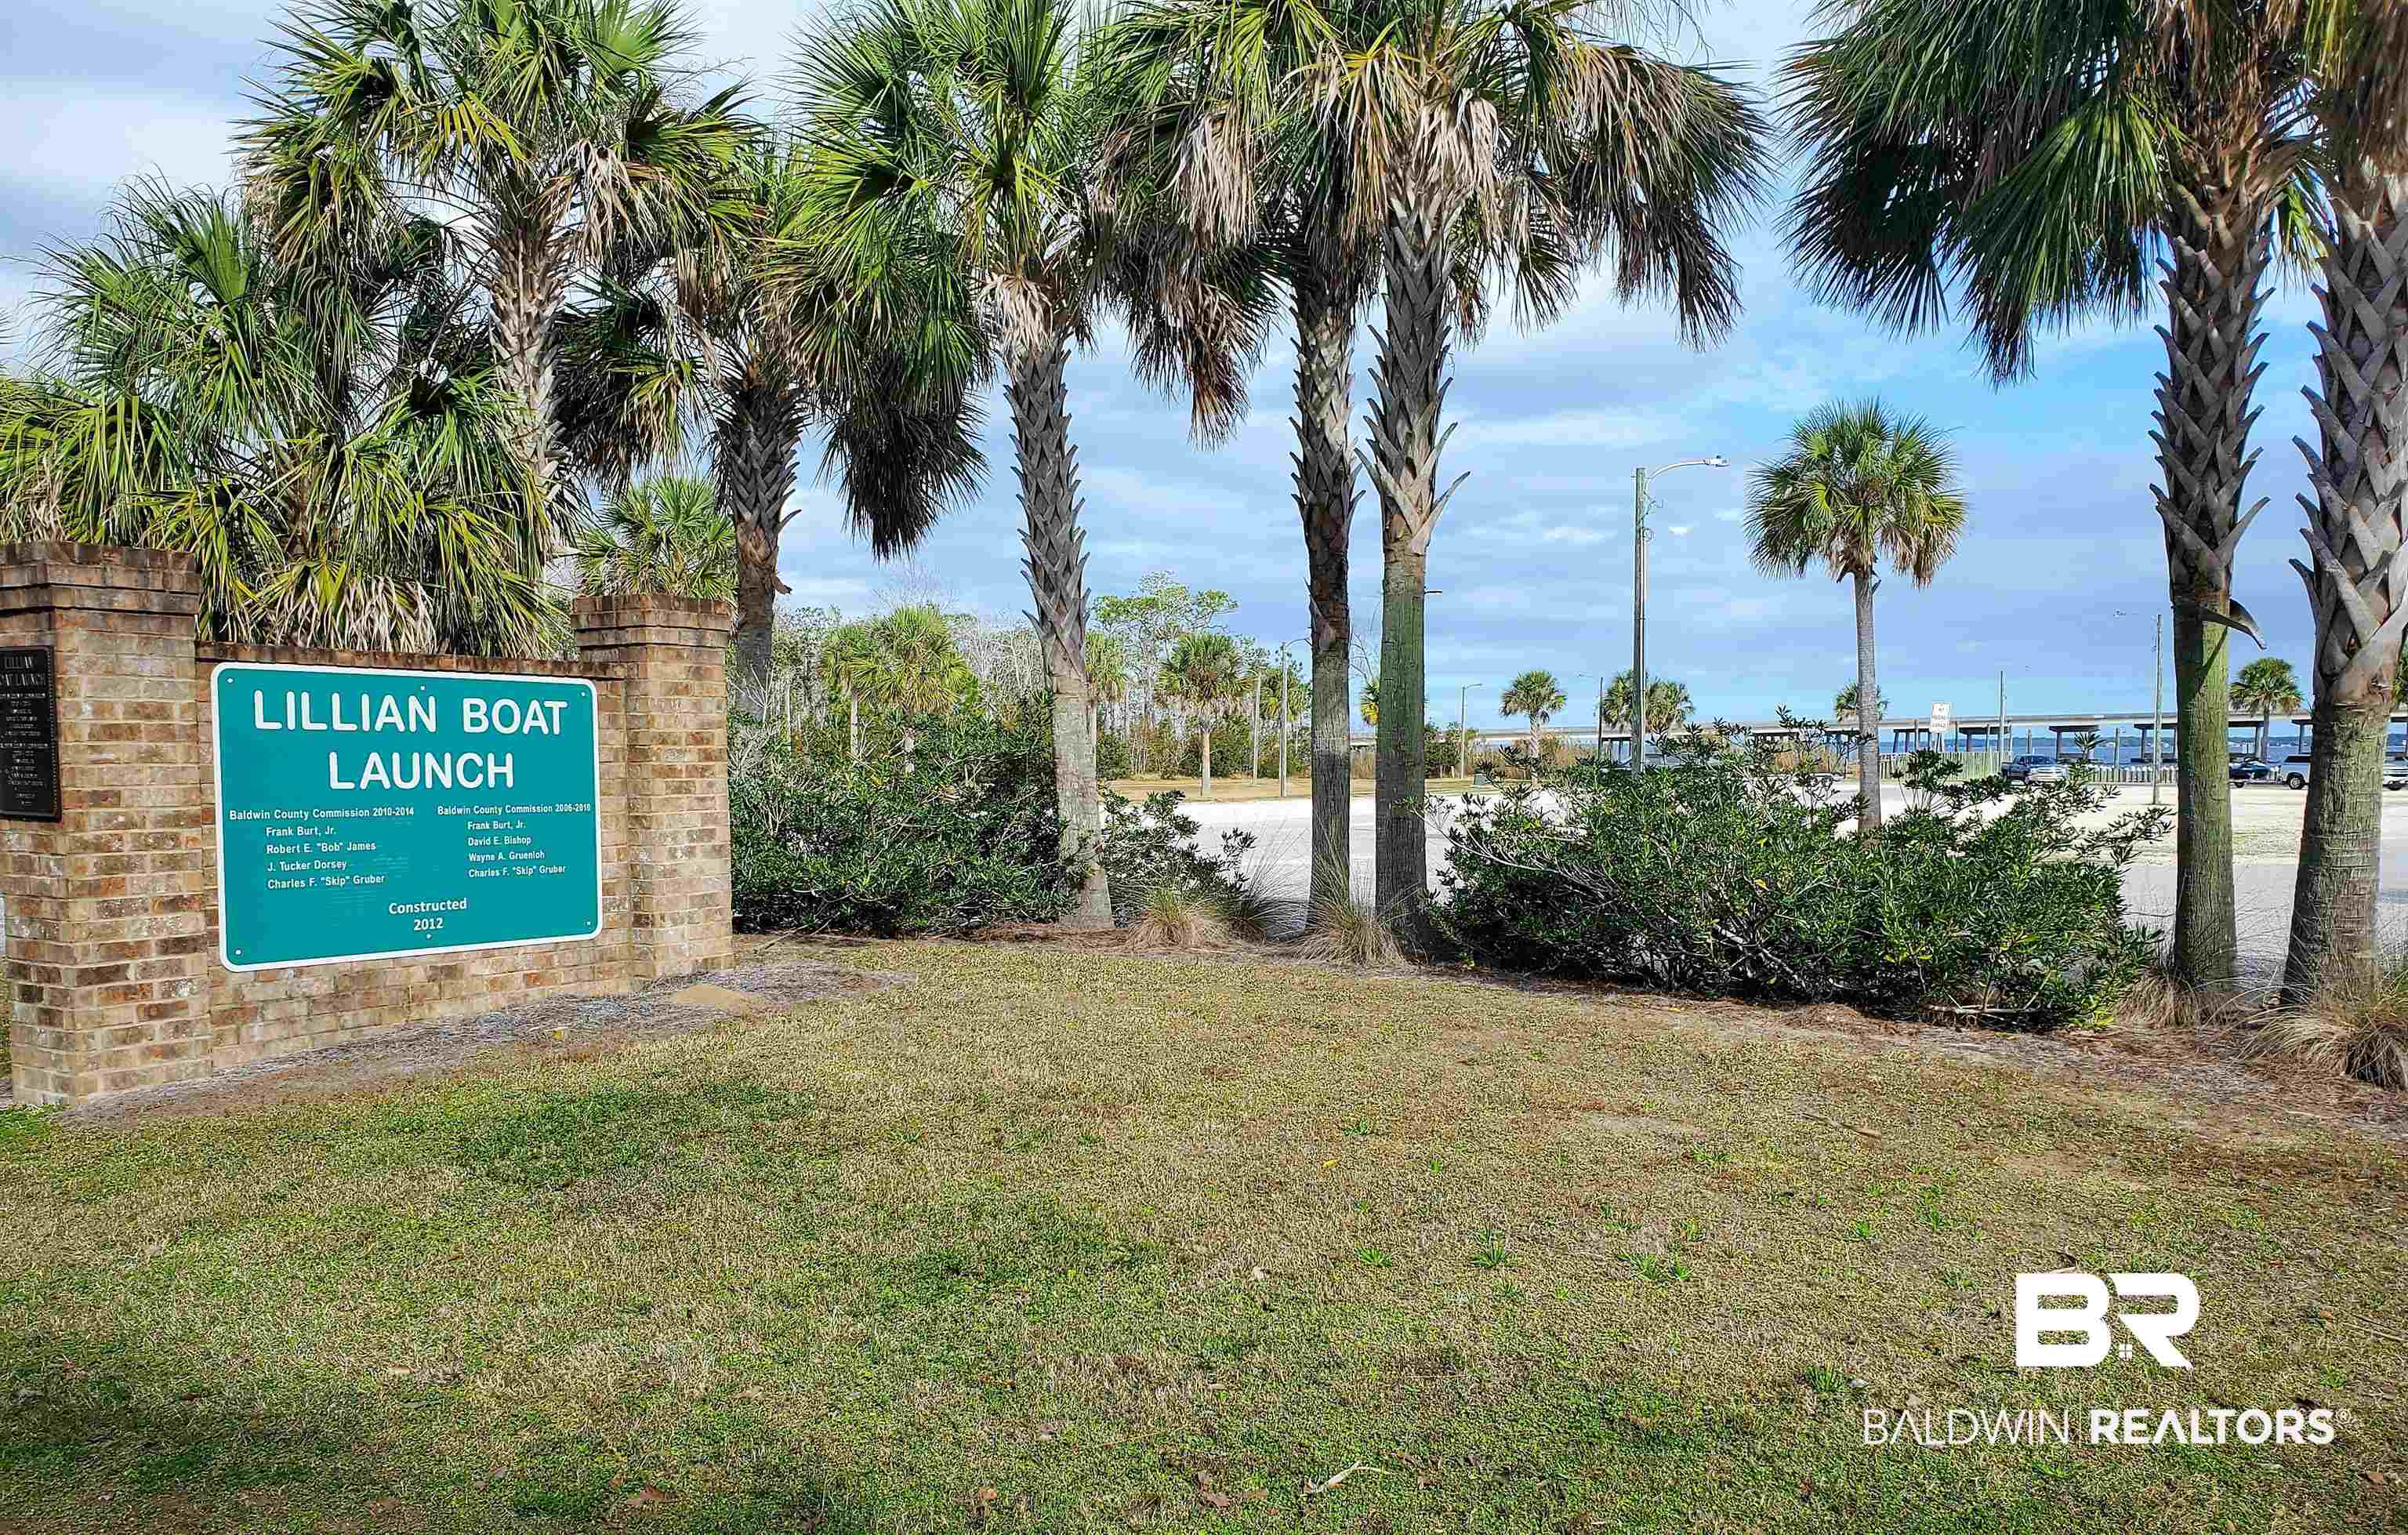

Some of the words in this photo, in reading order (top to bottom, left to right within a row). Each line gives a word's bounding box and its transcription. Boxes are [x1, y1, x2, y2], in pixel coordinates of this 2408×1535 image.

[253, 689, 437, 734] LILLIAN
[462, 697, 569, 735] BOAT
[328, 751, 515, 790] LAUNCH
[229, 810, 270, 820] Baldwin
[274, 809, 309, 820] County
[312, 807, 370, 818] Commission
[372, 807, 415, 817] 2010-2014
[437, 806, 471, 815] Baldwin
[473, 806, 502, 815] County
[505, 804, 553, 813] Commission
[266, 826, 294, 836] Frank
[296, 826, 321, 836] Burt,
[324, 826, 337, 835] Jr.
[467, 821, 490, 829] Frank
[492, 821, 513, 829] Burt,
[515, 820, 526, 829] Jr.
[267, 844, 300, 854] Robert
[303, 844, 314, 853] E.
[317, 842, 343, 852] "Bob"
[346, 841, 376, 851] James
[468, 837, 491, 847] David
[493, 836, 502, 846] E.
[504, 836, 531, 846] Bishop
[469, 853, 495, 863] Wayne
[498, 852, 506, 861] A.
[267, 862, 276, 871] J.
[279, 861, 311, 871] Tucker
[314, 859, 346, 870] Dorsey
[468, 869, 500, 878] Charles
[502, 868, 510, 876] F.
[513, 866, 537, 876] "Skip"
[539, 865, 567, 874] Gruber
[267, 878, 306, 889] Charles
[309, 878, 317, 887] F.
[321, 876, 350, 887] "Skip"
[353, 874, 385, 884] Gruber
[388, 897, 467, 916] Constructed
[413, 917, 444, 931] 2012
